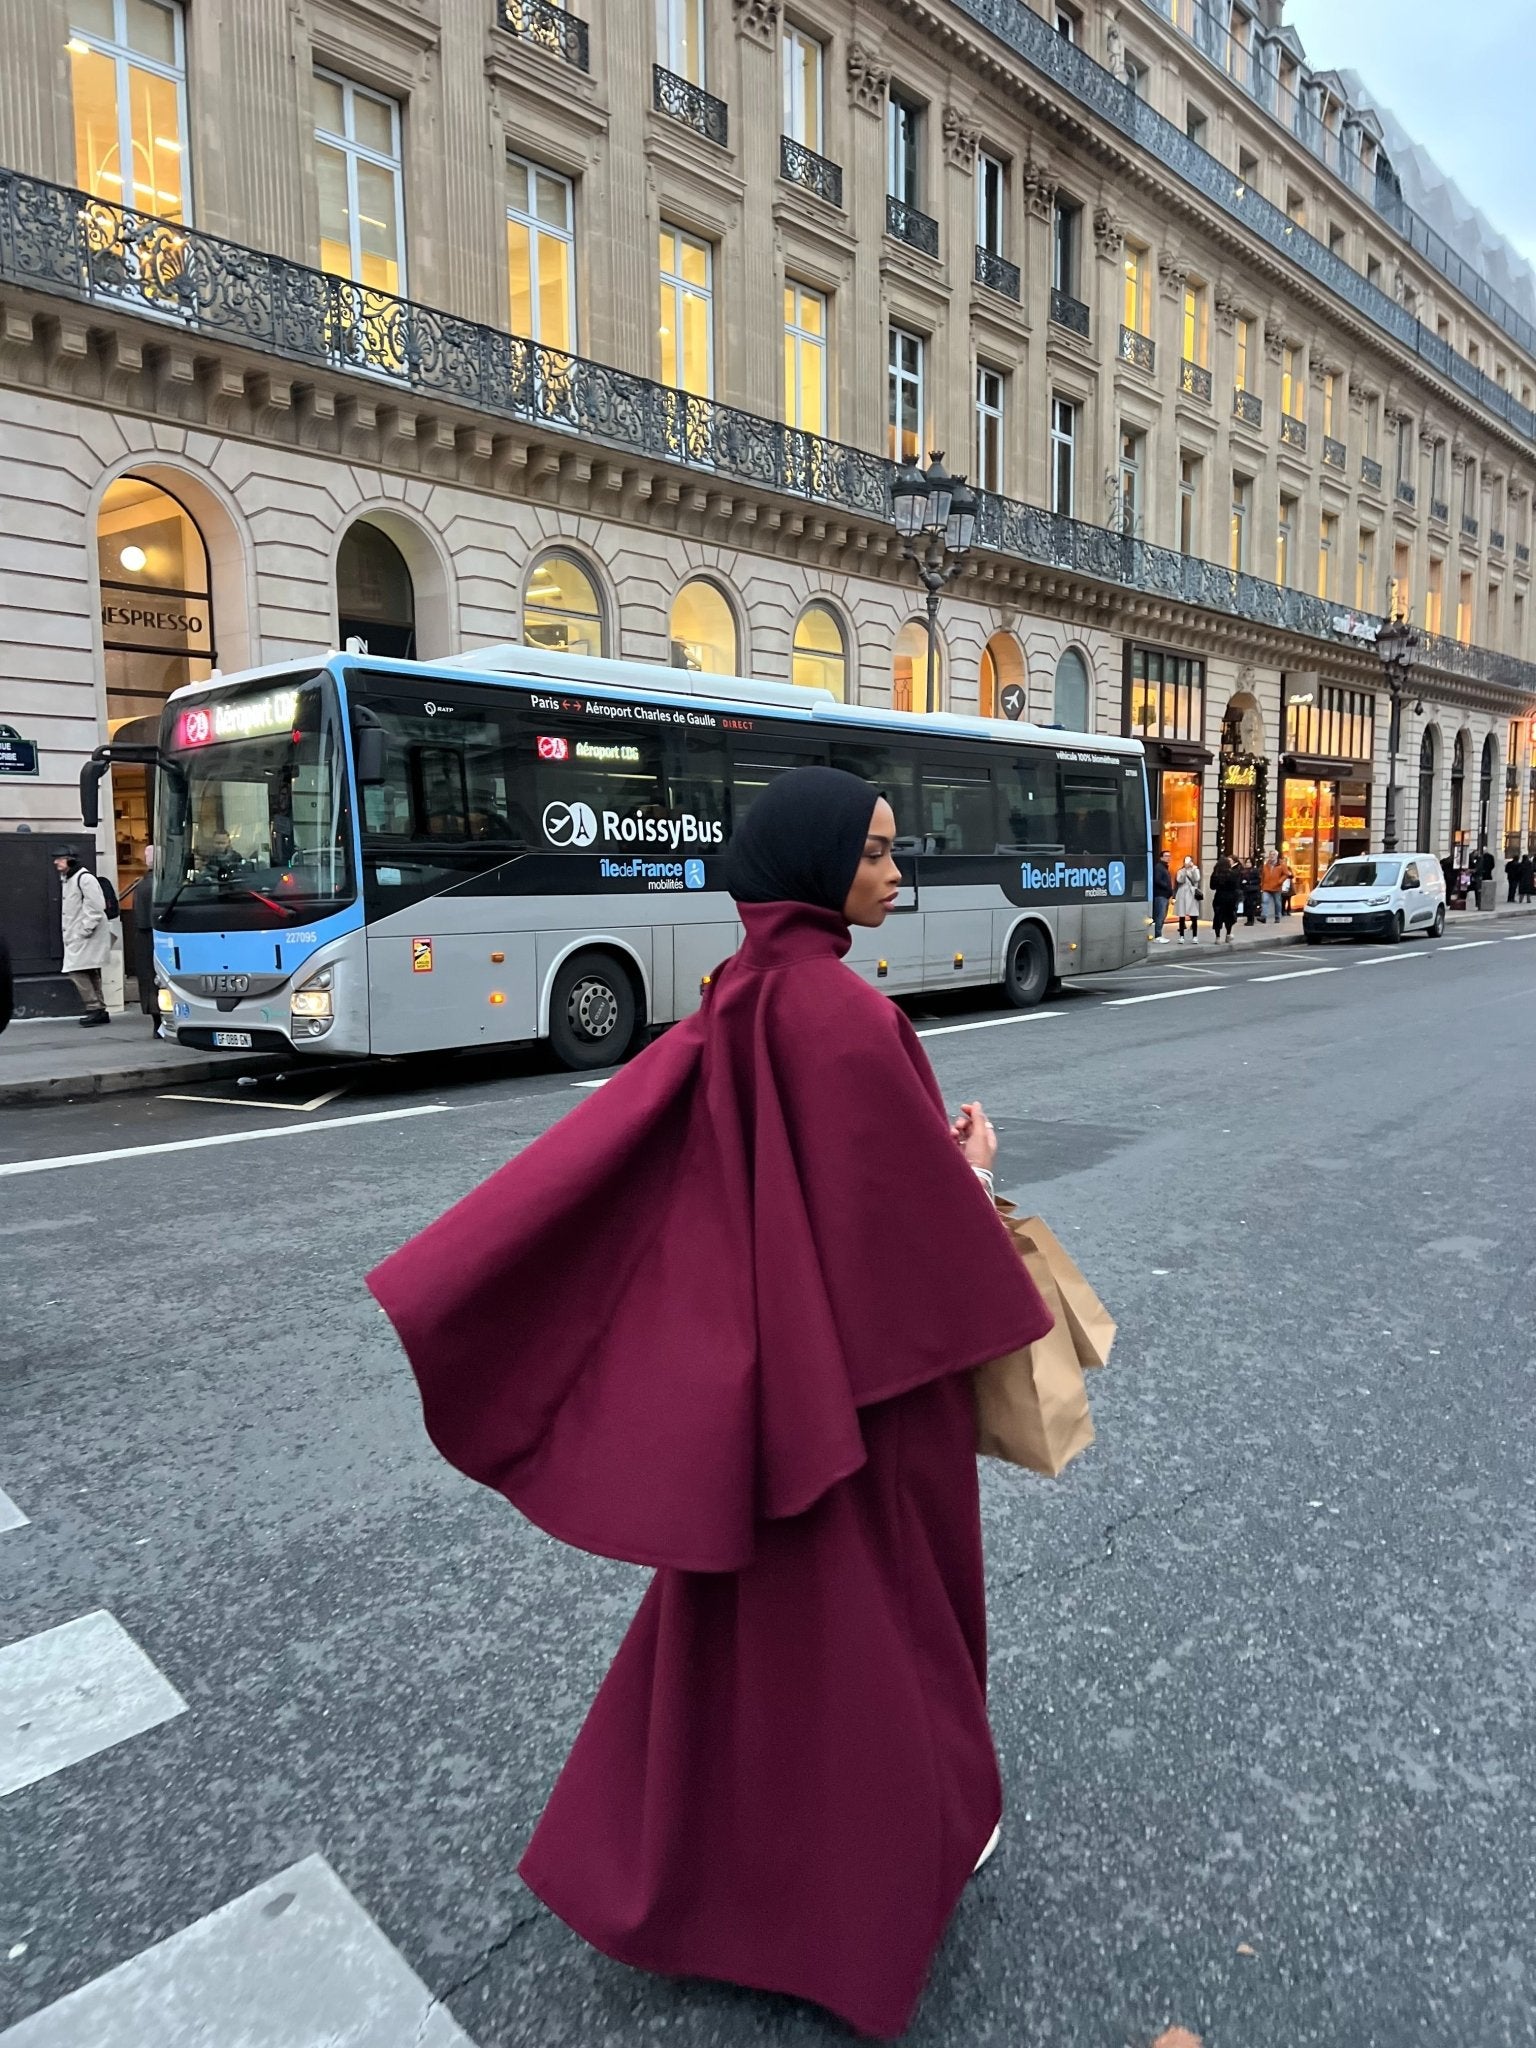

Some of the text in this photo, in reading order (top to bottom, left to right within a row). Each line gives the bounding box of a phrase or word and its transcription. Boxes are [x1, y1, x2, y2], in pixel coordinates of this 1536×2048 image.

[530, 694, 753, 730] Paris Aéroport Charles de Gaulle DIRECT
[575, 742, 620, 760] Aéroport
[602, 810, 723, 850] RoissyBus
[600, 858, 683, 877] îledeFrance
[1021, 862, 1107, 889] îledeFrance
[648, 879, 684, 890] mobilités
[1084, 887, 1108, 897] mobilités
[286, 931, 317, 944] 227095
[200, 974, 249, 993] IVECO
